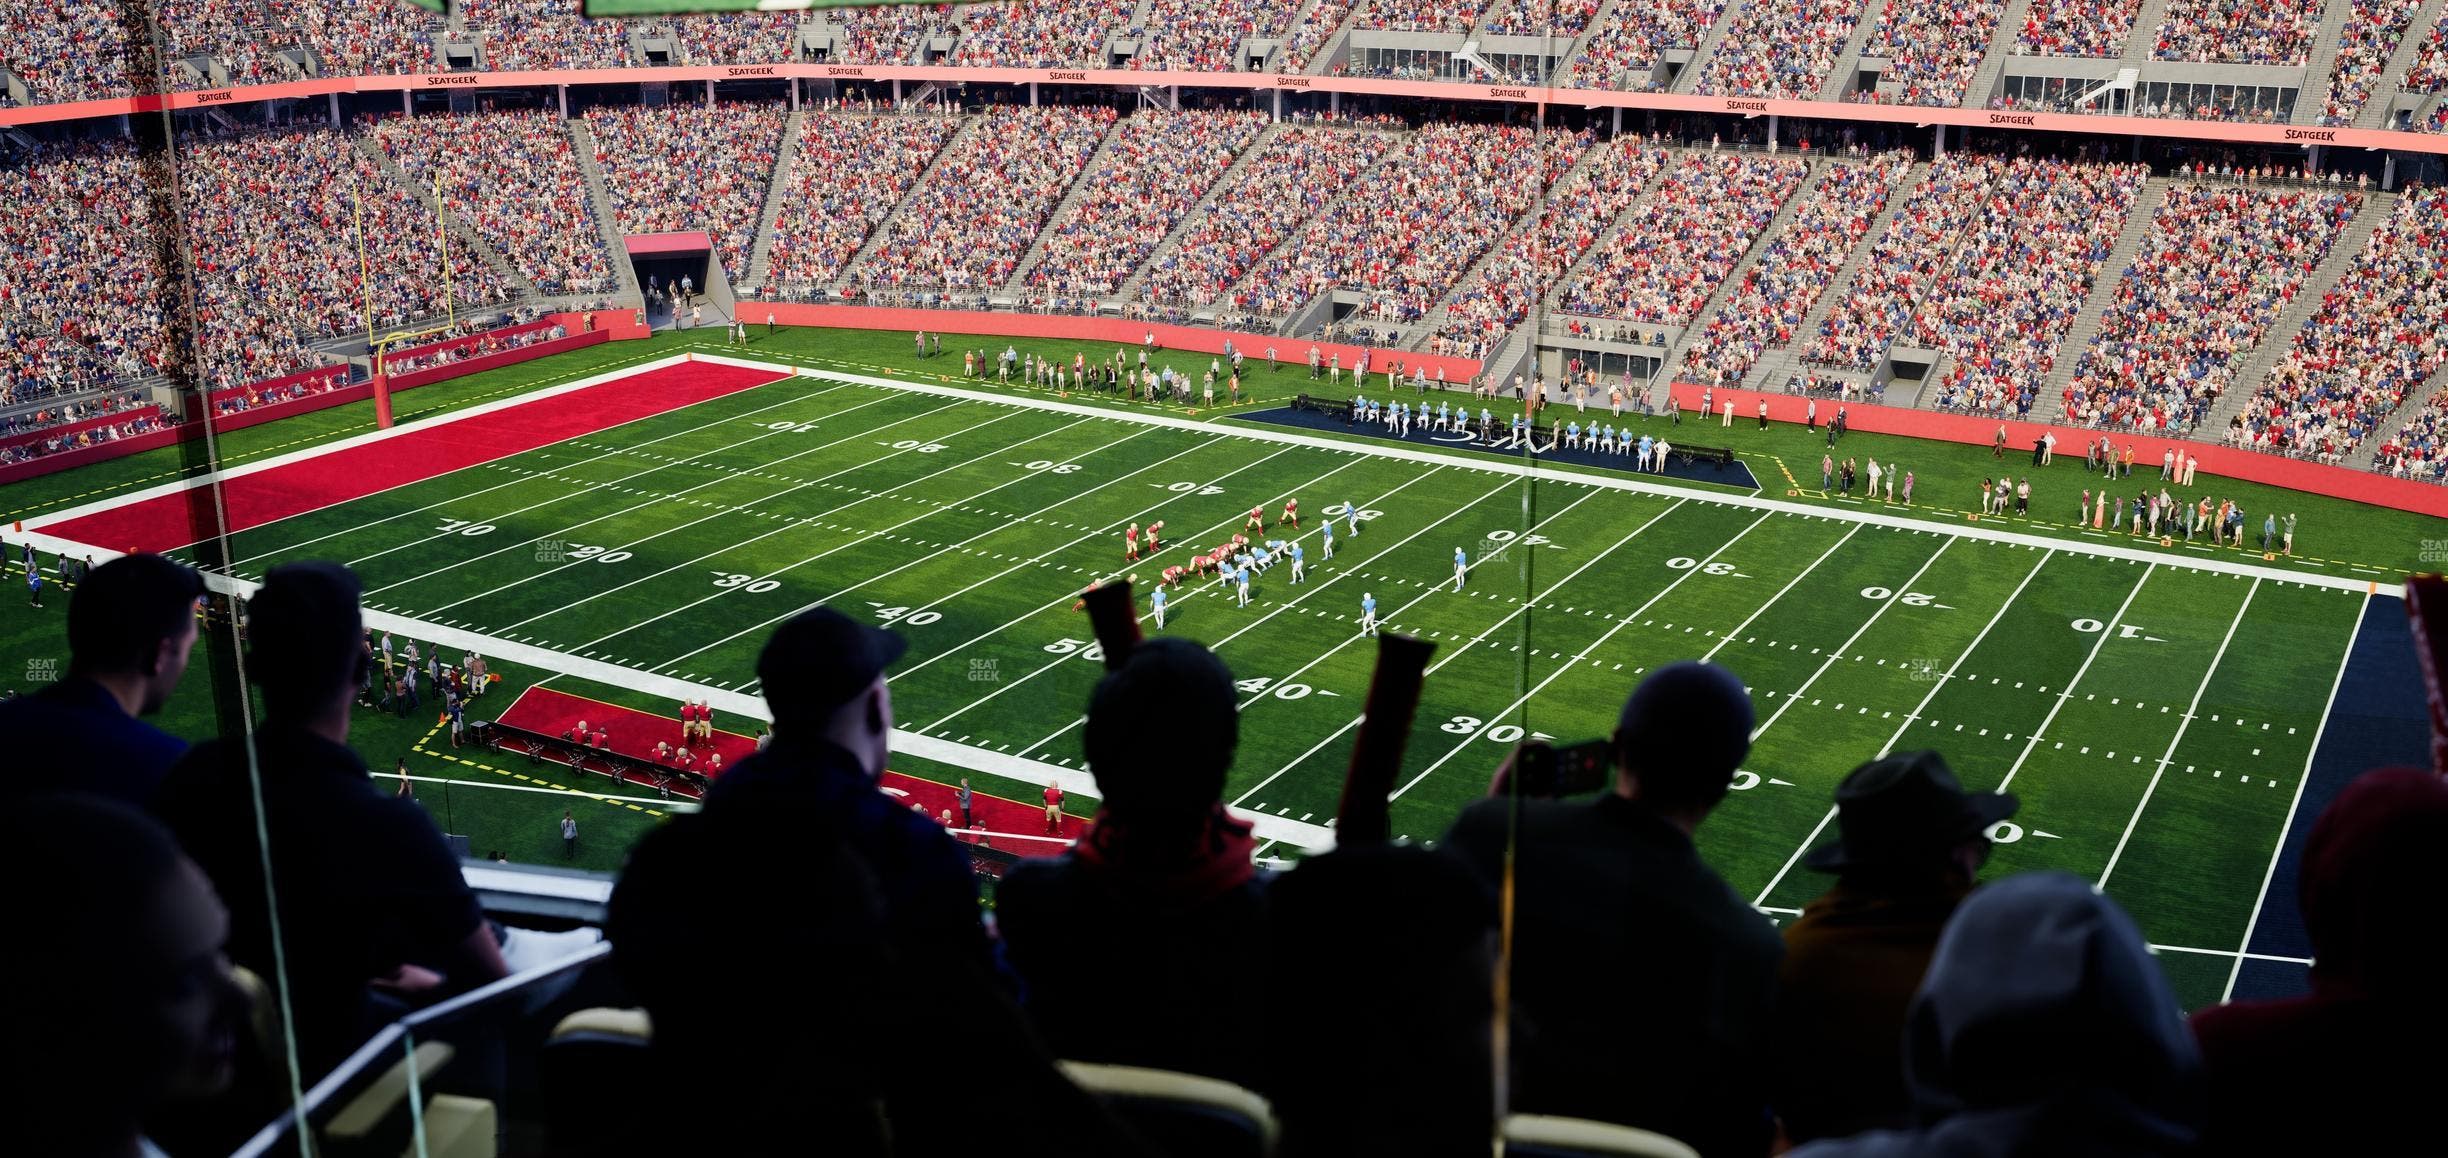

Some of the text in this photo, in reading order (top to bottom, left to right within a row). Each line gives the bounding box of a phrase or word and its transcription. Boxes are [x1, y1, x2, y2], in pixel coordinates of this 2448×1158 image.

[728, 67, 774, 78] SEATGEEK
[829, 67, 864, 76] SEATGEEK
[1050, 71, 1086, 81] SEATGEEK
[428, 75, 478, 86] SEATGEEK
[1277, 77, 1310, 87] SEATGEEK
[197, 91, 233, 103] SEATGEEK
[1490, 87, 1527, 98] SEATGEEK
[1727, 99, 1768, 112] SEATGEEK
[1989, 113, 2034, 126] SEATGEEK
[2284, 128, 2335, 143] SEATGEEK
[768, 421, 819, 433] 10
[1025, 460, 1082, 474] 30
[1168, 482, 1225, 495] 40
[436, 520, 496, 536] 10
[567, 546, 632, 563] 20
[1666, 557, 1736, 575] 30
[713, 574, 780, 593] 30
[1861, 587, 1936, 606] 20
[876, 605, 943, 625] 40
[2071, 618, 2143, 638] 10
[1235, 677, 1312, 699] 40
[1441, 715, 1525, 743] 30
